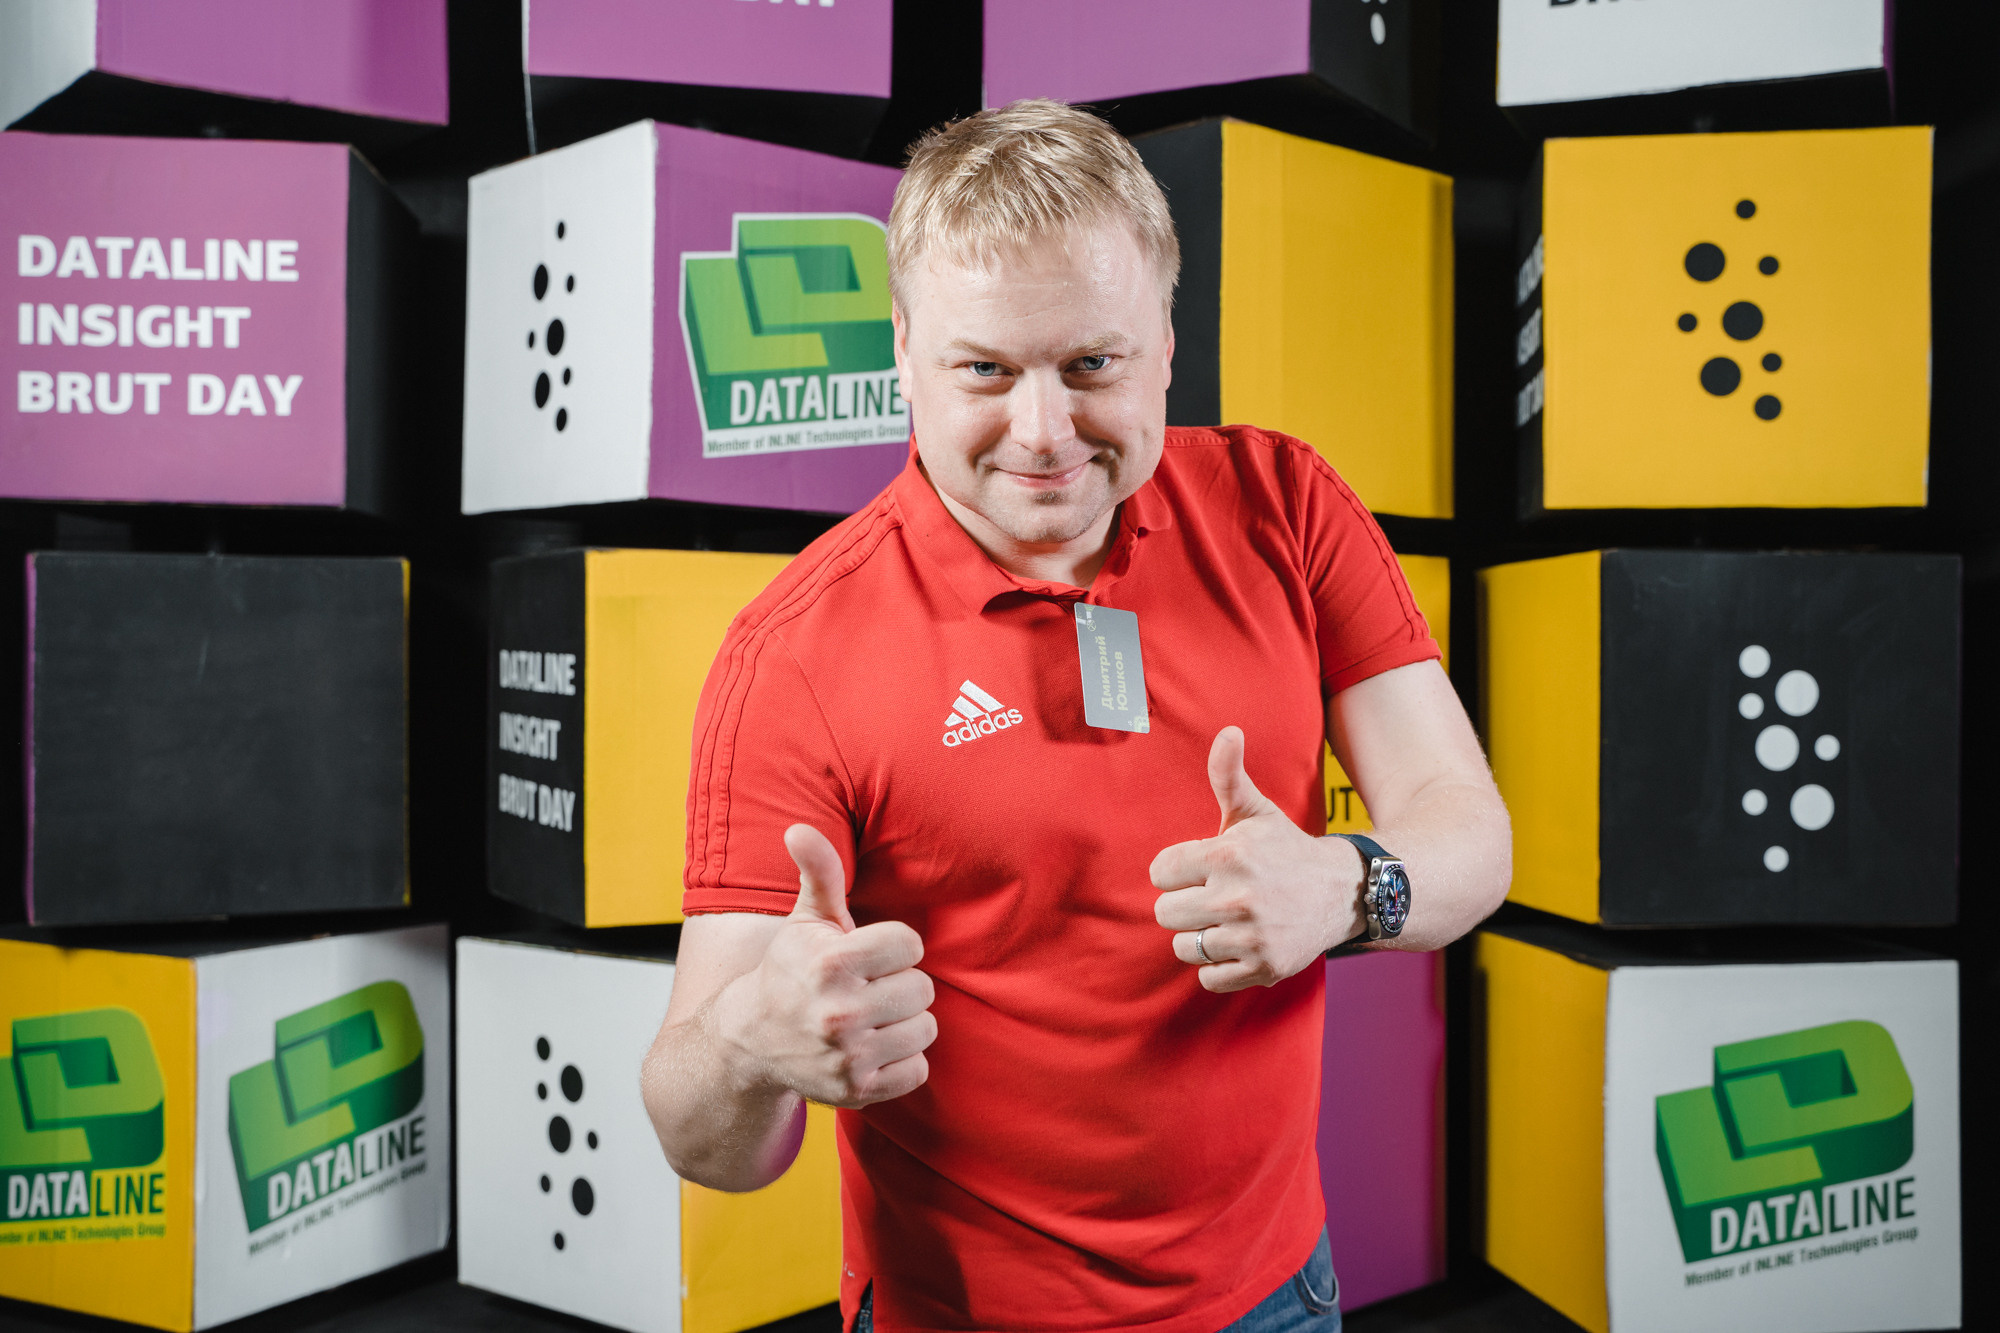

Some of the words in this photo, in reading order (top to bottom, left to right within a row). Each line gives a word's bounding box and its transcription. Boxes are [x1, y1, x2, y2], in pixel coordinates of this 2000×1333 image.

[18, 234, 299, 282] DATALINE
[18, 303, 251, 348] INSIGHT
[17, 370, 172, 415] BRUT
[187, 373, 303, 416] DAY
[730, 375, 904, 425] DATALINE
[500, 650, 576, 695] DATALINE
[1094, 634, 1114, 711] Дмитрий
[1115, 651, 1129, 711] Юшков
[500, 712, 561, 760] INSIGHT
[942, 708, 1023, 747] adidas
[499, 773, 537, 821] BRUT
[539, 784, 576, 832] DAY
[267, 1115, 426, 1211] DATALINE
[8, 1170, 164, 1219] DATALINE
[1711, 1176, 1916, 1254] DATALINE
[1685, 1266, 1734, 1287] Member
[1738, 1262, 1751, 1276] of
[1800, 1236, 1879, 1262] Technologies
[1882, 1227, 1919, 1245] Group
